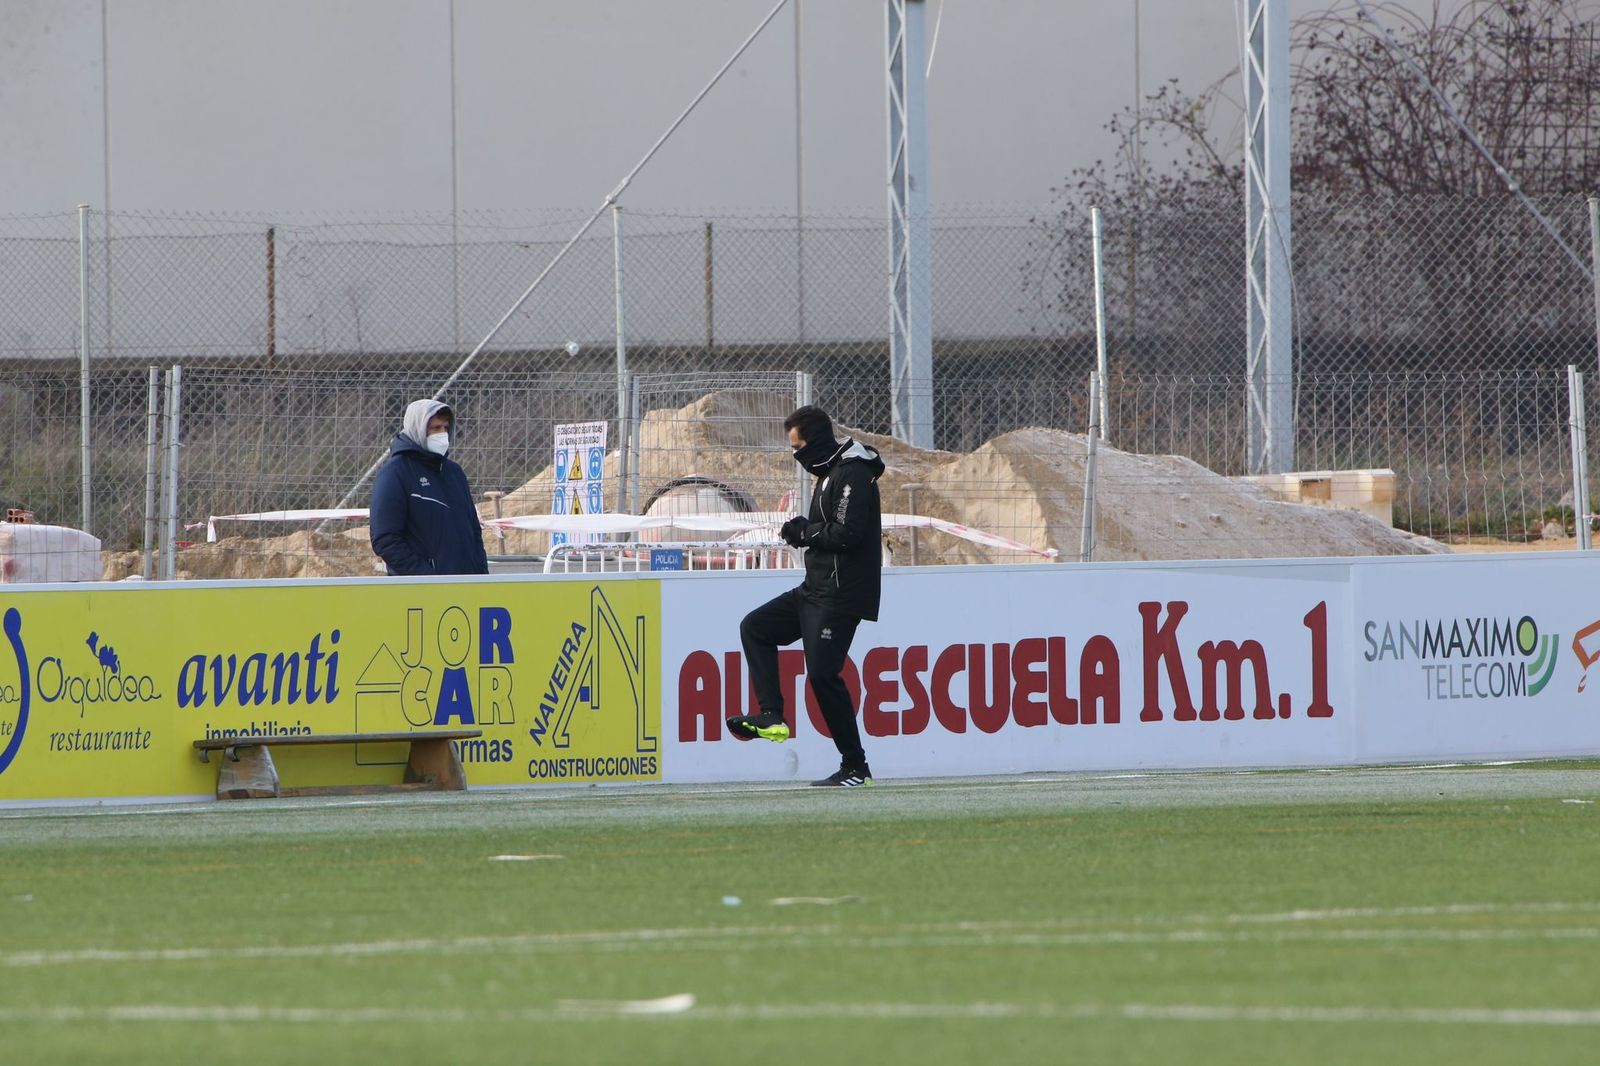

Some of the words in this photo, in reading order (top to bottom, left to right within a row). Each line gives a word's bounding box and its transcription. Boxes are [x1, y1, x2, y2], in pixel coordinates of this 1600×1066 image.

[400, 605, 514, 668] JOR
[177, 629, 341, 709] avanti
[400, 665, 515, 726] CAR
[529, 621, 587, 746] NAVEIRA
[678, 634, 1121, 742] AUTOESCUELA
[1421, 661, 1527, 700] TELECOM
[49, 729, 151, 752] restaurante
[528, 756, 657, 778] CONSTRUCCIONES
